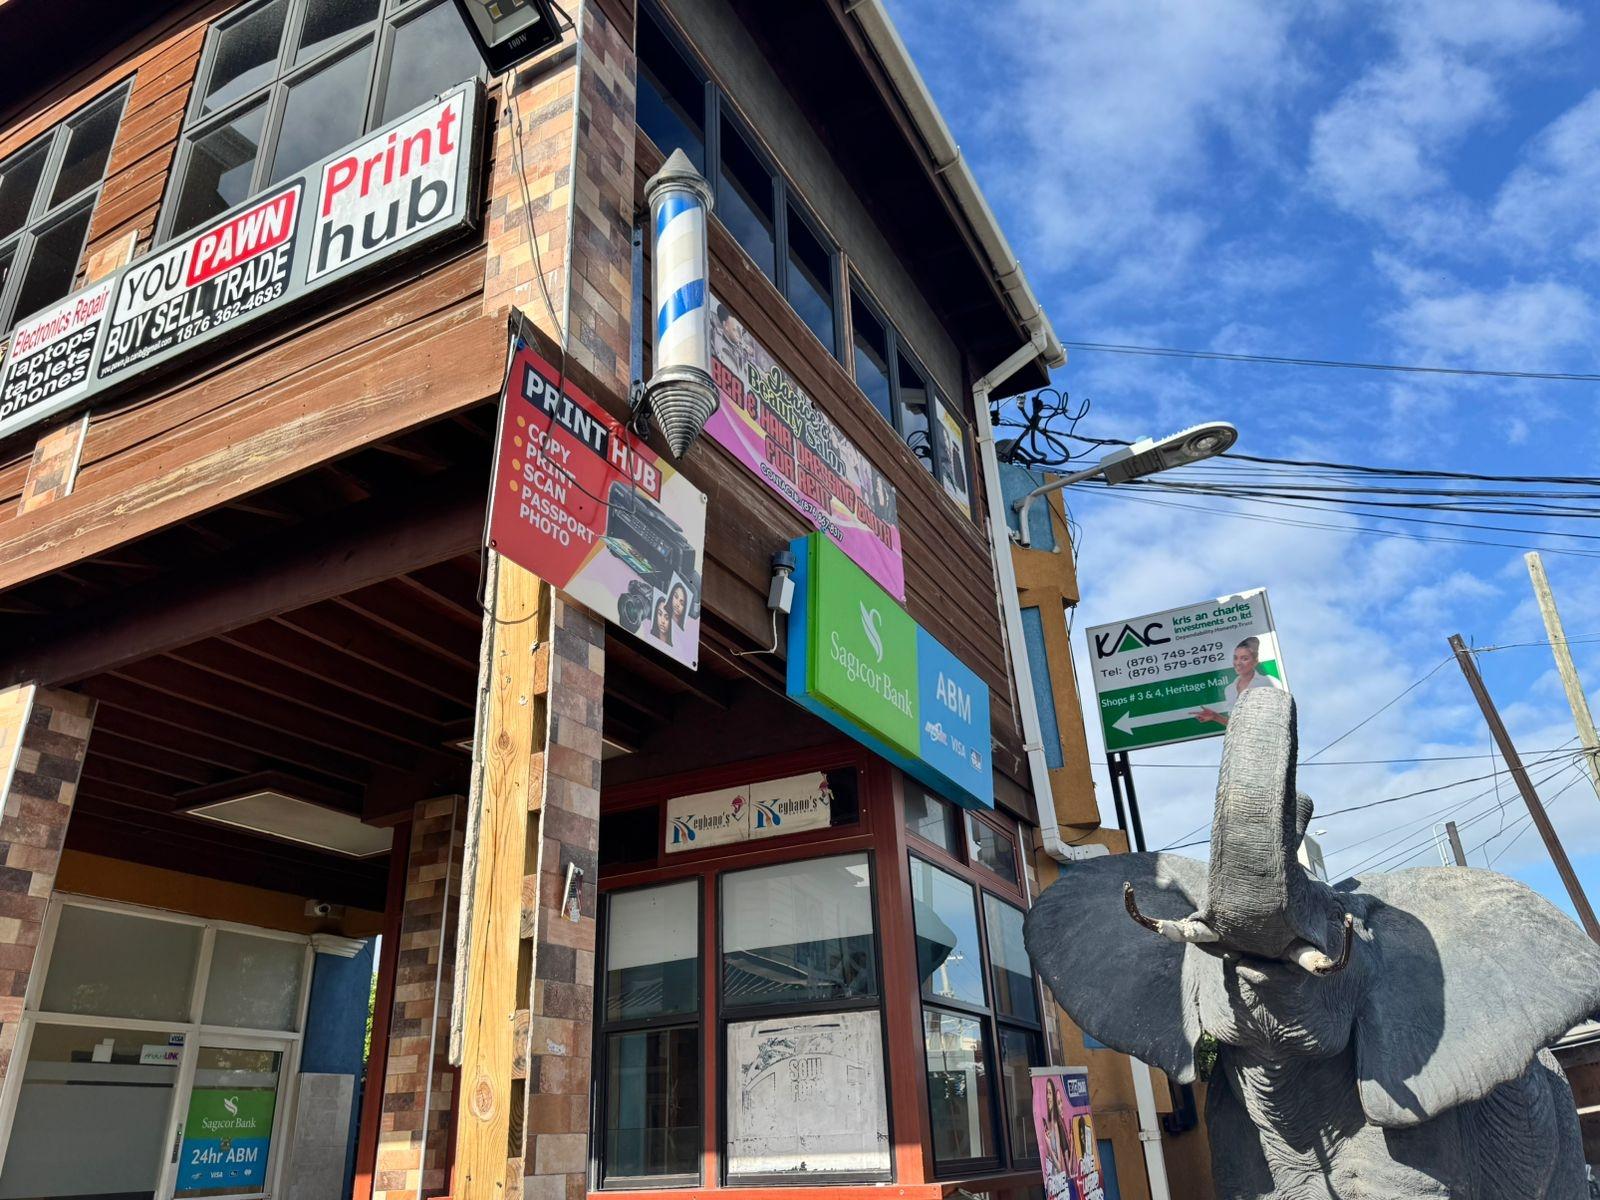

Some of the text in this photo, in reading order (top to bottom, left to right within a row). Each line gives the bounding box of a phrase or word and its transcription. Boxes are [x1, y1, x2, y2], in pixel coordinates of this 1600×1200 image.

[508, 33, 528, 50] 100W
[322, 103, 456, 218] Print
[316, 175, 448, 273] hub
[128, 198, 287, 311] YOU PAWN
[12, 286, 110, 358] Electronics Repair
[103, 242, 291, 363] BUY SELL TRADE
[176, 318, 209, 343] 1876
[214, 282, 282, 326] 362-4693
[4, 347, 91, 400] tablets
[9, 326, 96, 380] laptops
[0, 365, 86, 418] phones
[526, 369, 656, 492] PRINT HUB
[528, 424, 571, 464] COPY
[711, 356, 744, 411] BER
[760, 404, 794, 458] HAIR
[796, 438, 856, 513] DRESSING
[747, 361, 848, 480] Beauty Salon
[524, 463, 566, 504] SCAN
[526, 442, 576, 488] PRINT
[765, 435, 833, 516] FOR RENT
[520, 503, 569, 546] PHOTO
[522, 485, 594, 544] PASSPORT
[1095, 622, 1171, 659] KAC
[1172, 603, 1250, 626] kris an charles
[1174, 618, 1224, 634] investments
[830, 631, 913, 718] Sagicor Bank
[1101, 667, 1122, 678] Tel:
[1128, 666, 1160, 680] (876)
[1127, 655, 1158, 669] (876)
[936, 671, 972, 725] ABM
[1101, 695, 1128, 708] Shops
[1129, 694, 1136, 702] #
[1138, 692, 1144, 700] 3
[1146, 690, 1153, 699] &
[1165, 683, 1206, 696] Heritage
[1208, 676, 1229, 687] Mall
[202, 1117, 256, 1132] Sagicor Bank
[191, 1147, 258, 1164] 24hr ABM
